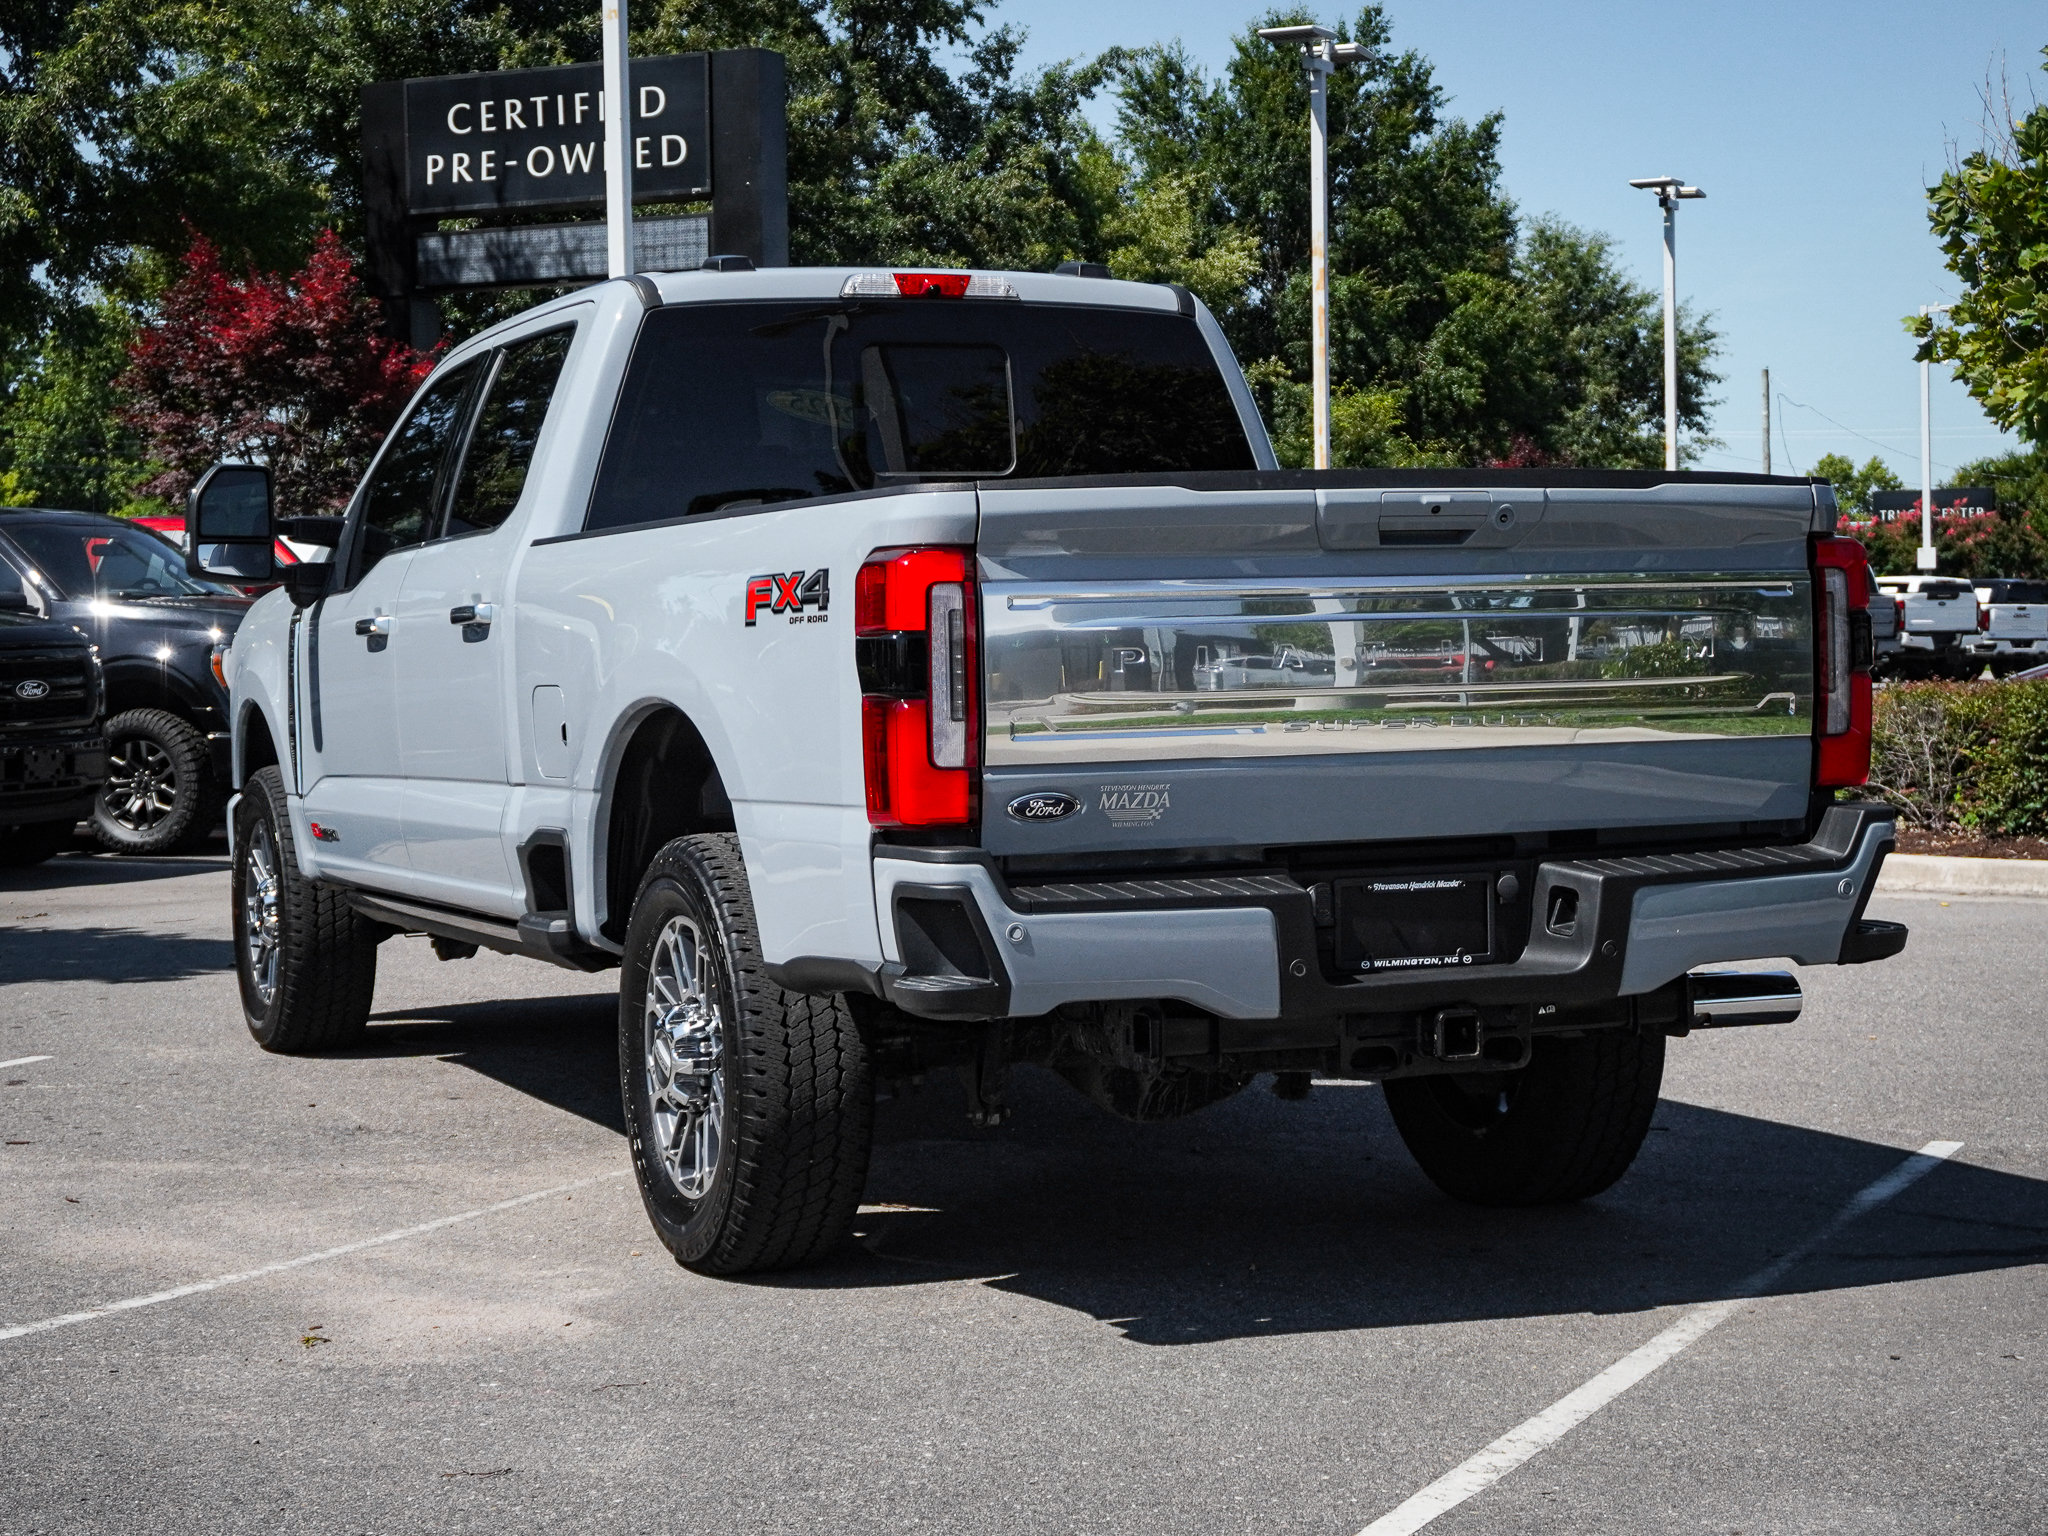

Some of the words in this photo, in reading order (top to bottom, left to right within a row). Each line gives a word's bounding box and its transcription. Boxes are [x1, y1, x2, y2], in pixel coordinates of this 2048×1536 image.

[447, 86, 666, 135] CERTIFID
[426, 134, 688, 185] PRE-OWED
[745, 568, 830, 627] FX4
[789, 616, 804, 625] OFF
[807, 614, 828, 623] ROAD
[1283, 717, 1439, 733] SUPER
[1451, 712, 1562, 728] DUTY
[1100, 784, 1137, 792] STEVENSON
[1138, 783, 1171, 791] HENDRICK
[1099, 791, 1170, 809] MAZDA
[1373, 883, 1408, 891] Stevenson
[1409, 881, 1436, 891] Hendrick
[1374, 957, 1442, 967] WILMINGTON,
[1444, 956, 1459, 964] NC
